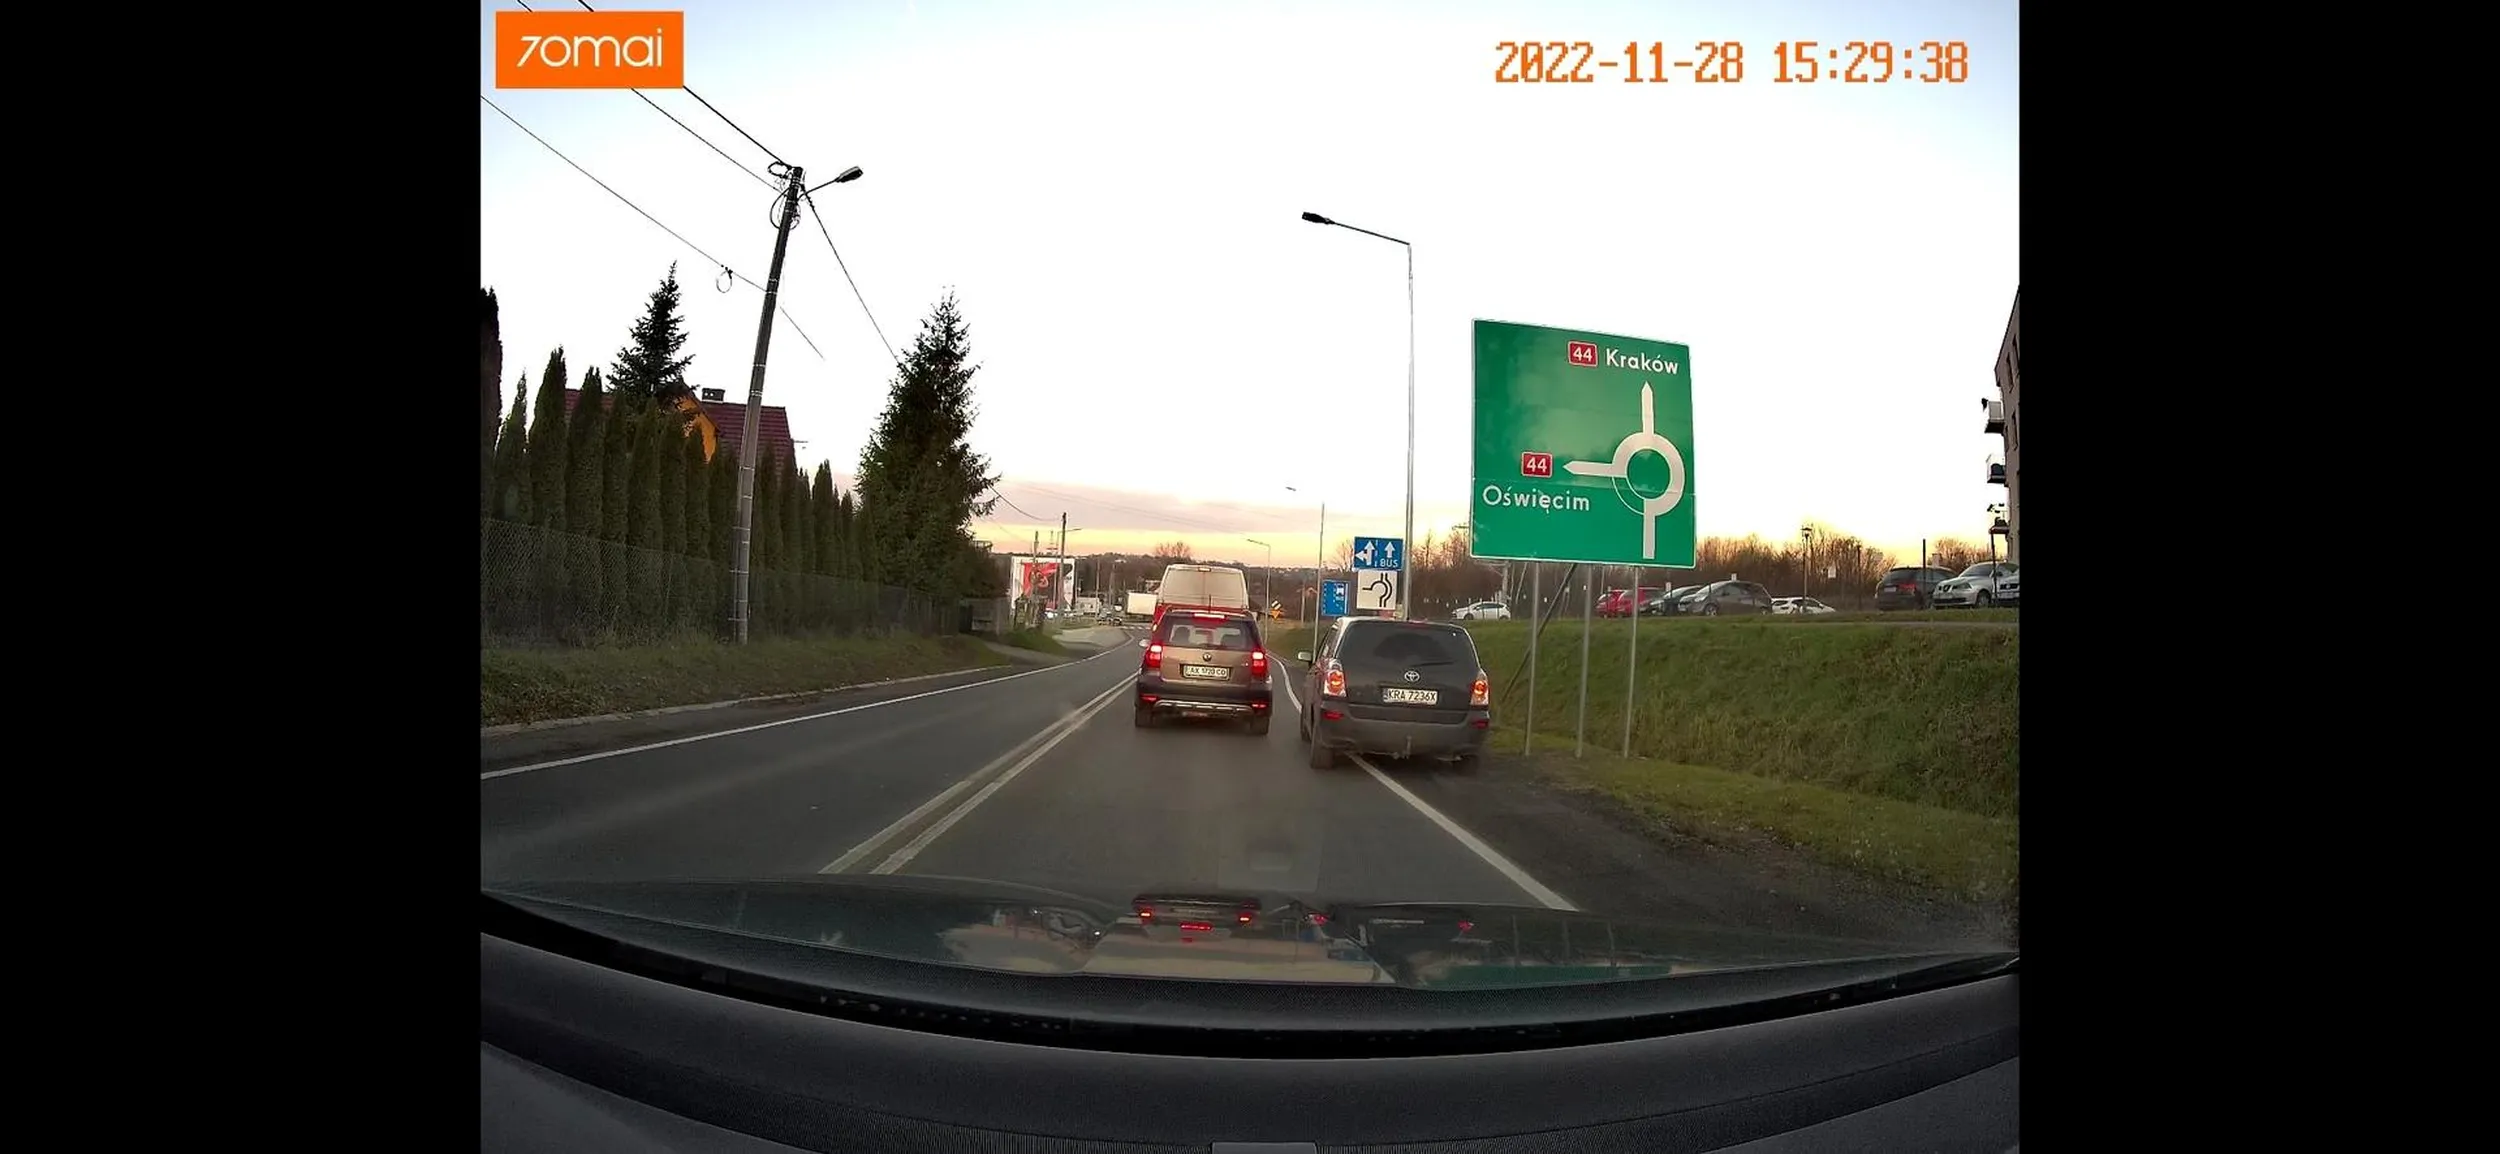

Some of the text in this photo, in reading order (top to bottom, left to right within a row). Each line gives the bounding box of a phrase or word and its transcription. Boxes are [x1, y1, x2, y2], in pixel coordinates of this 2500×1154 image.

[1572, 347, 1679, 375] 44 Kraków
[1526, 457, 1547, 473] 44
[1483, 485, 1590, 514] Oświęcim
[1379, 558, 1399, 568] BUS
[1388, 688, 1436, 702] KRA 7236X
